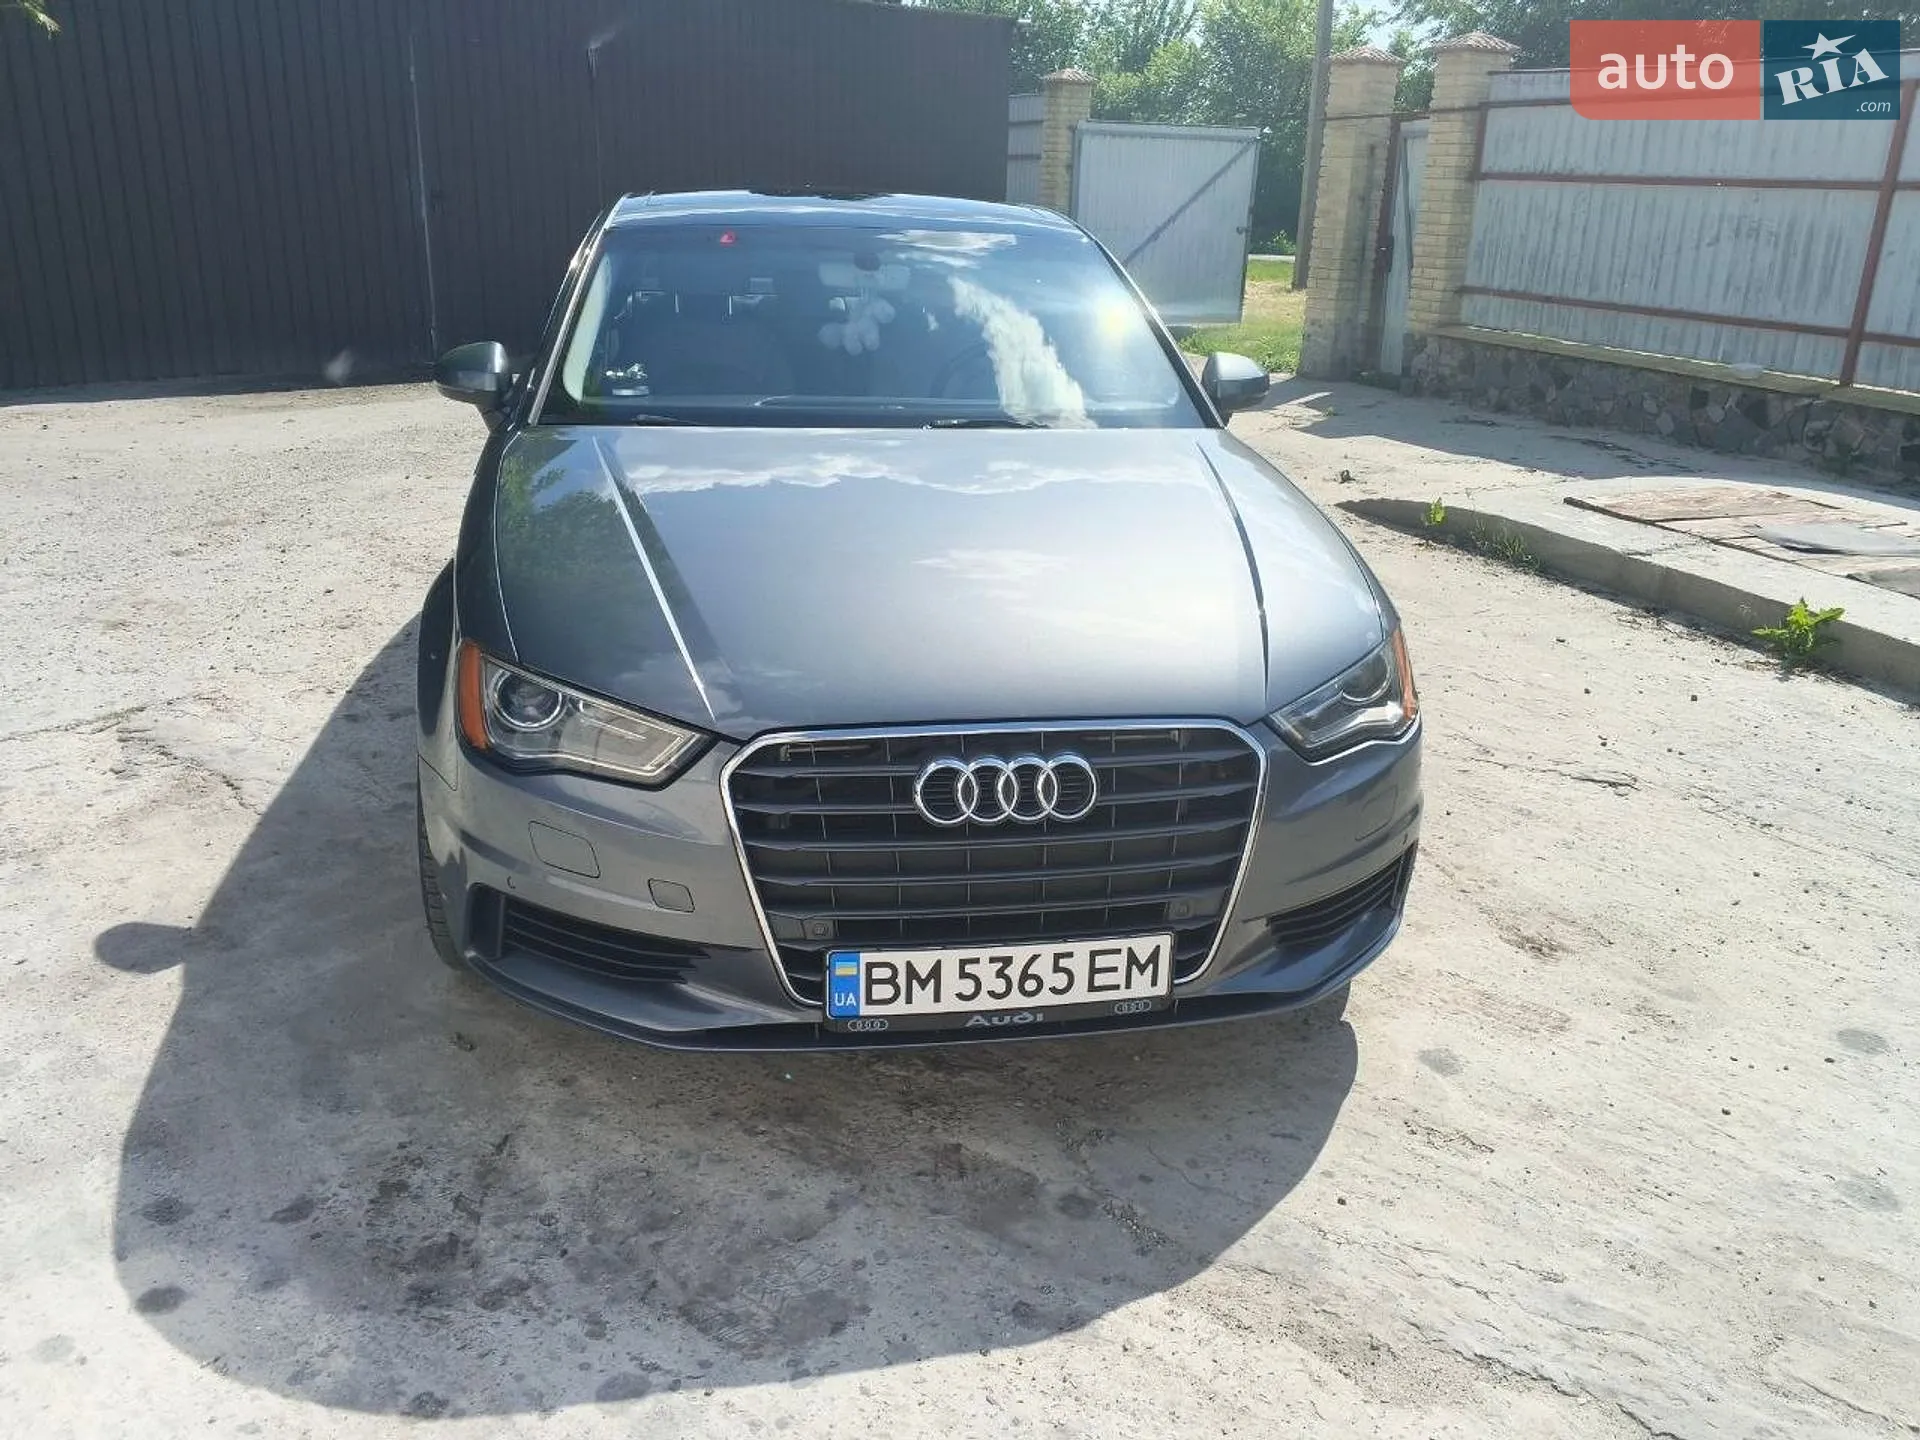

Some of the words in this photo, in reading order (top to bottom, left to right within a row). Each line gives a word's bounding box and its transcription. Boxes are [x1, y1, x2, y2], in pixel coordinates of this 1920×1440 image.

[864, 958, 942, 1007] BM
[955, 952, 1076, 1002] 5365
[1086, 944, 1162, 993] EM
[834, 992, 857, 1008] UA
[964, 1011, 1045, 1028] Audi
